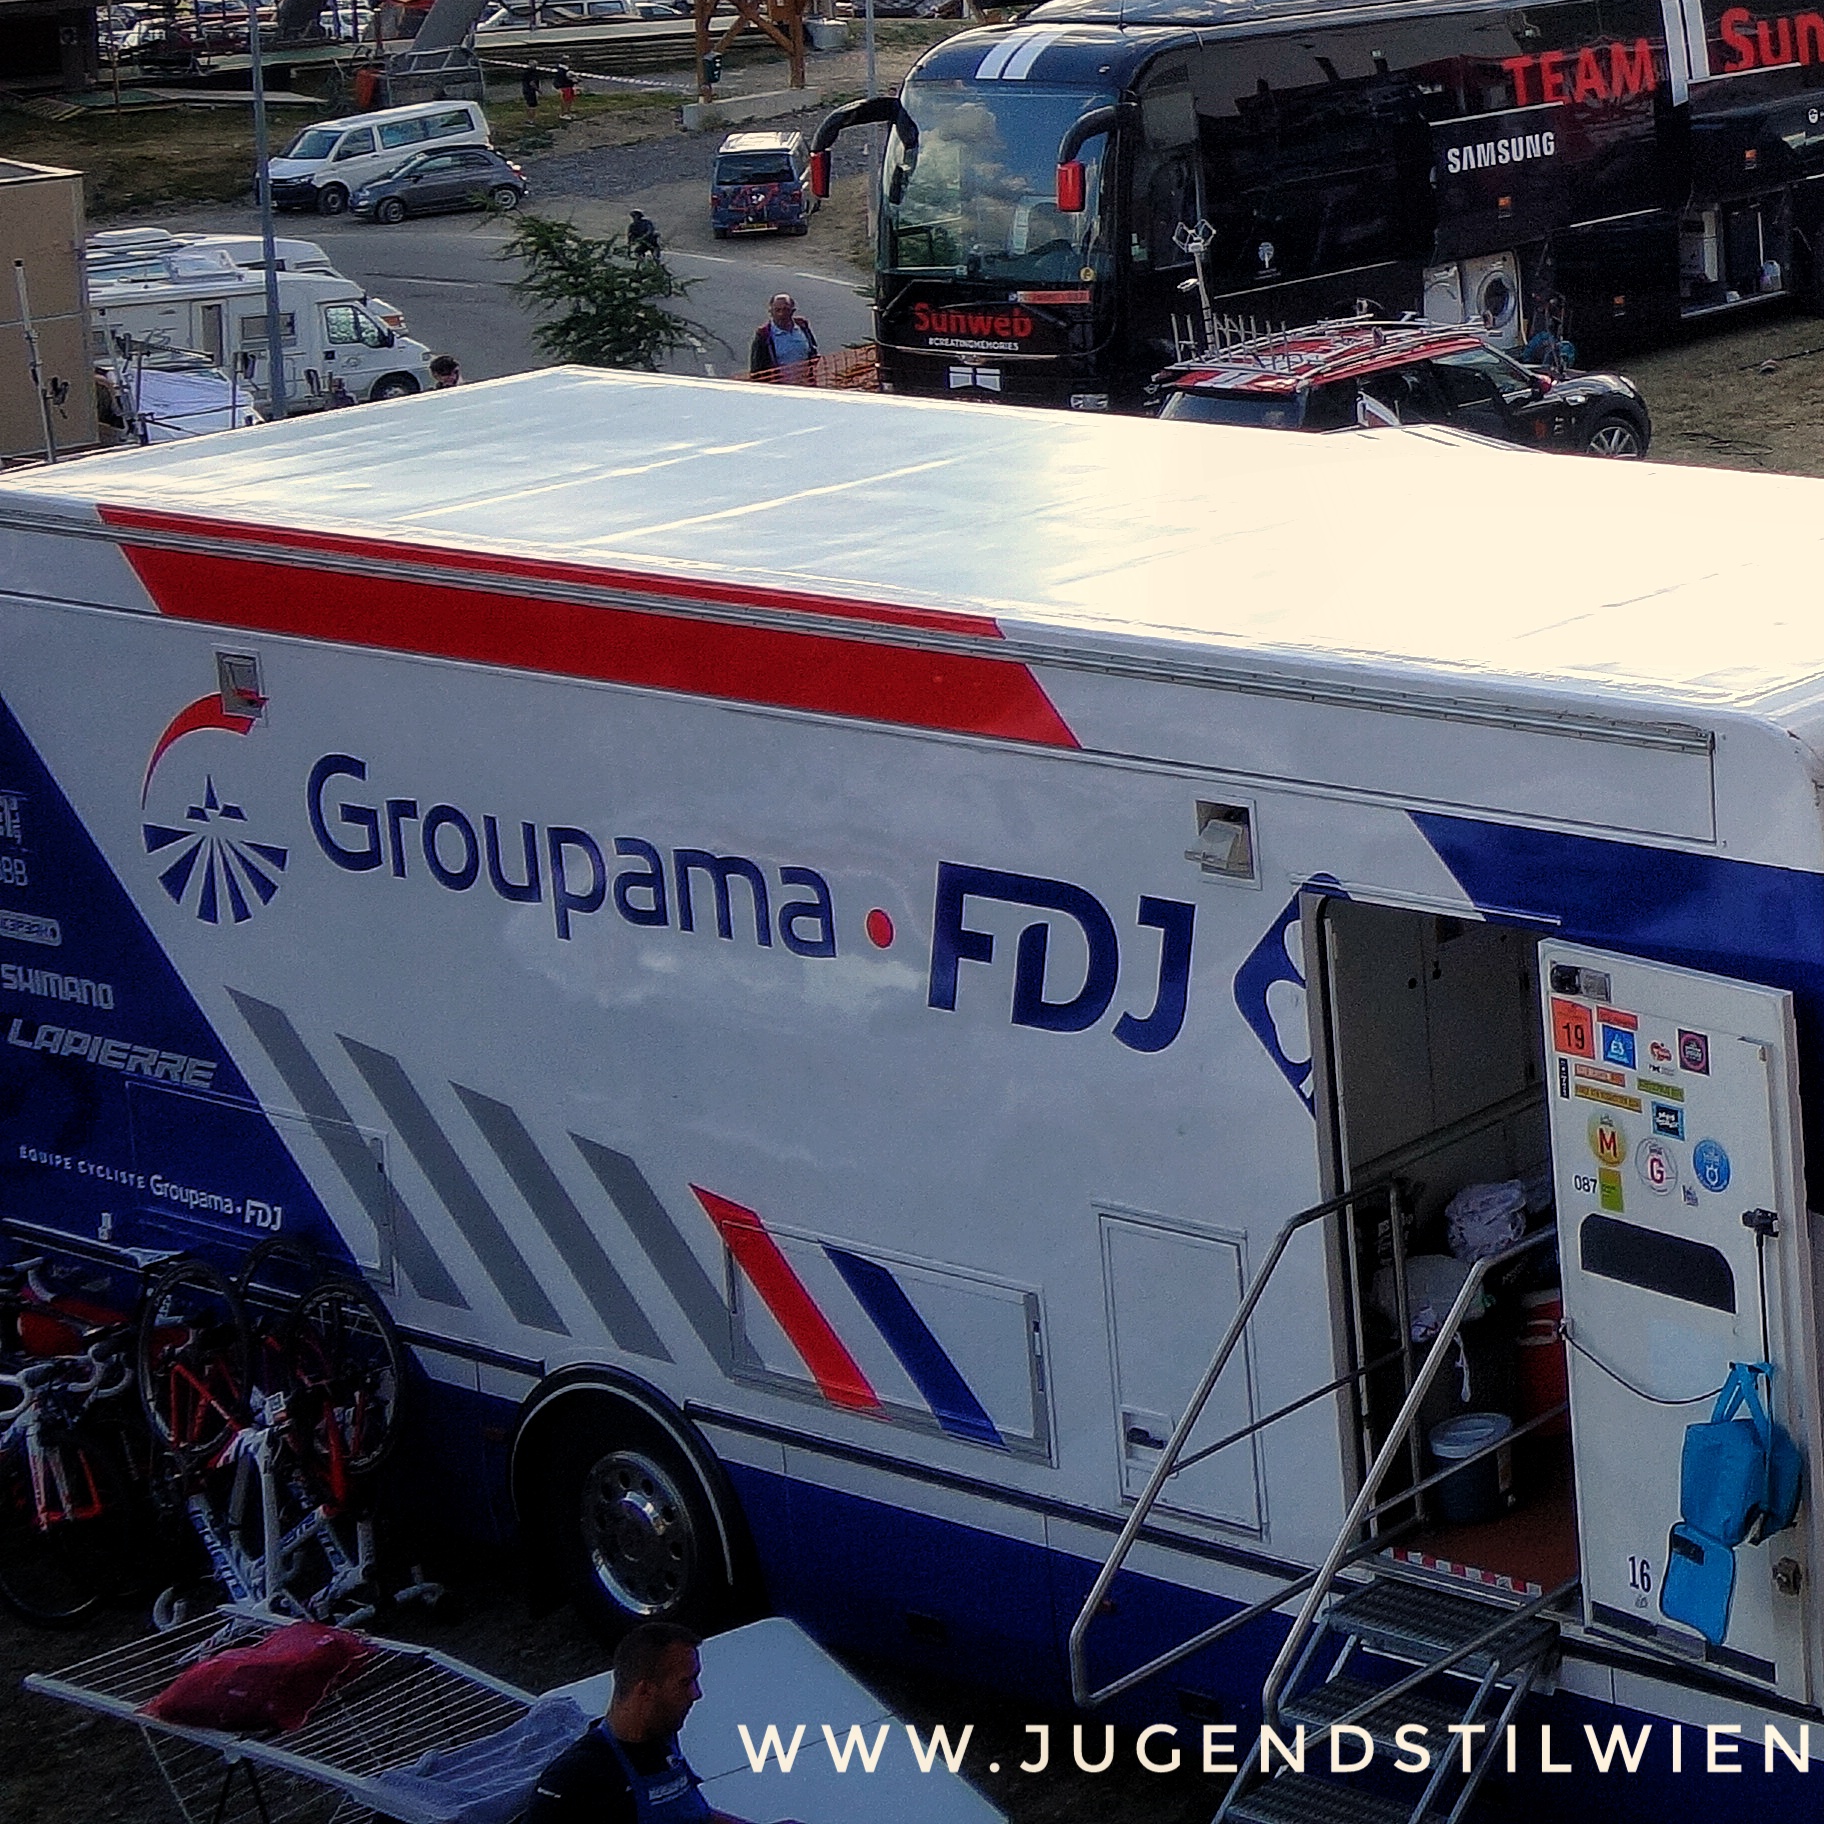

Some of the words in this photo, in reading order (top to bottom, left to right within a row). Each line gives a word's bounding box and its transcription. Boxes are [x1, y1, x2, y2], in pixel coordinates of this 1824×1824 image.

[1500, 37, 1657, 106] TEAM
[1446, 131, 1556, 174] SAMSUNG
[913, 302, 1033, 338] Sunweb
[307, 754, 837, 959] Groupama
[927, 860, 1197, 1054] FDJ
[1, 964, 115, 1010] SHIMANO
[7, 1018, 218, 1089] LAPIERRE
[1562, 1022, 1586, 1051] 19
[1599, 1127, 1618, 1158] M
[1574, 1174, 1597, 1194] 087
[1649, 1157, 1664, 1184] G
[77, 1160, 146, 1189] CYCLISTE
[150, 1174, 234, 1215] Groupama
[244, 1198, 283, 1232] FDJ
[1627, 1554, 1652, 1594] 16
